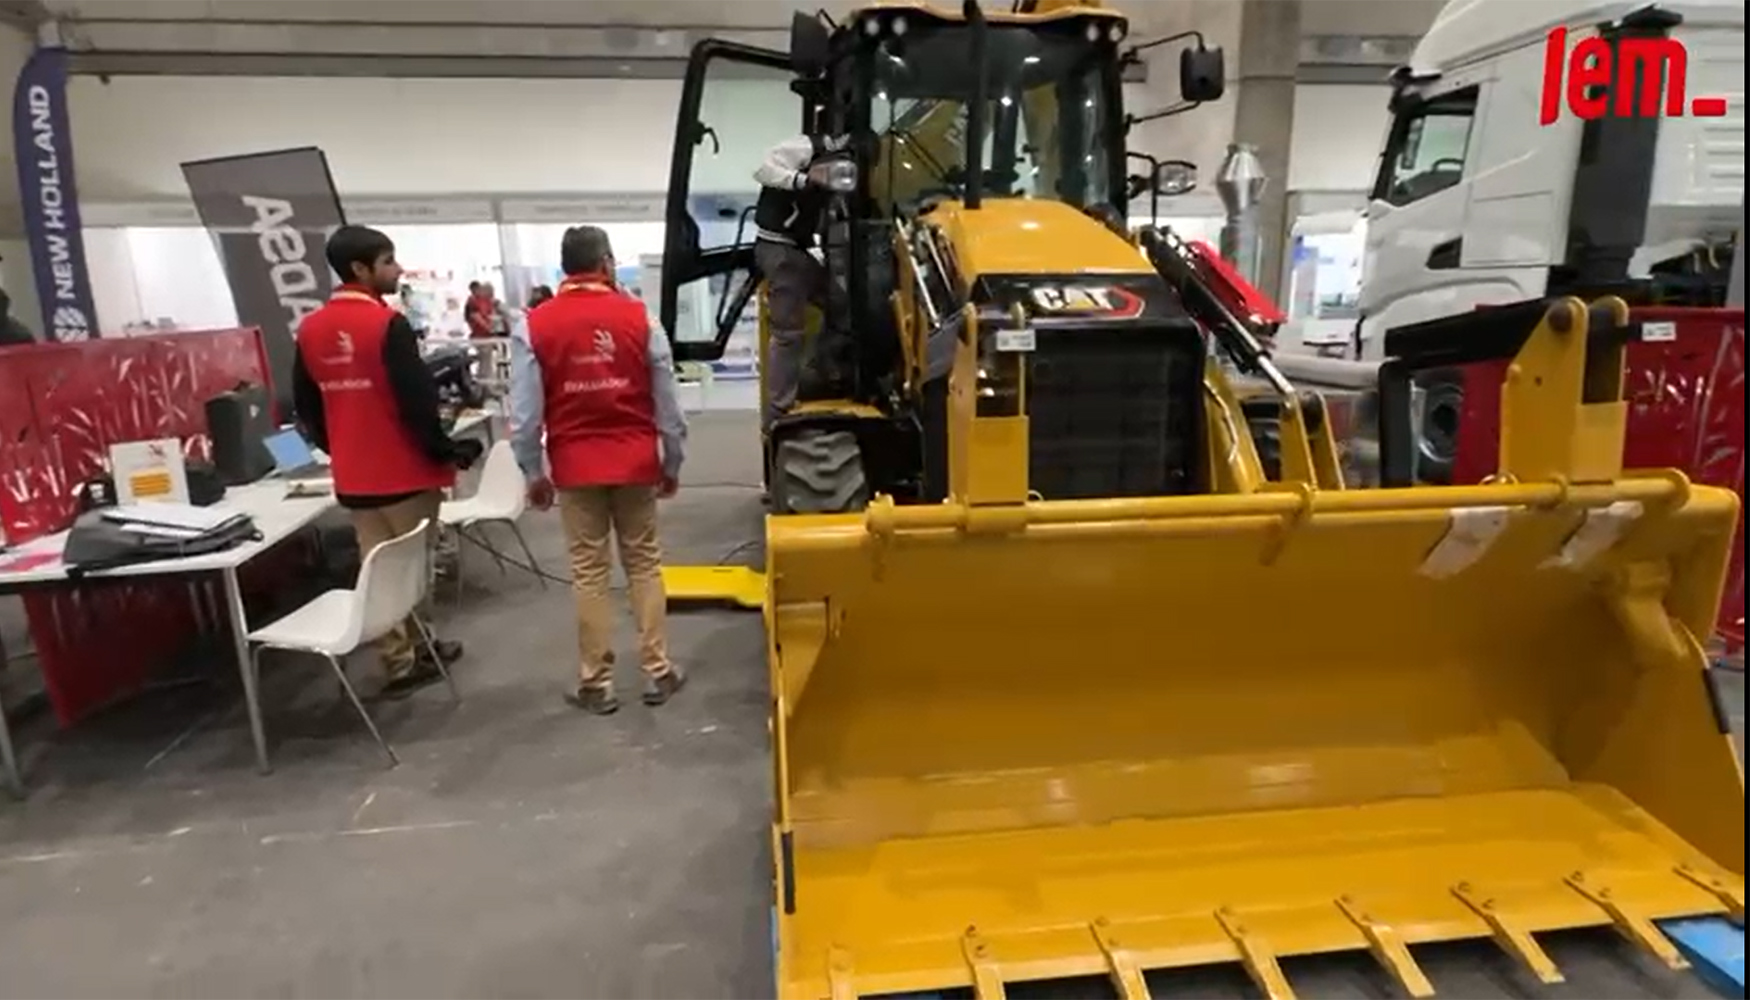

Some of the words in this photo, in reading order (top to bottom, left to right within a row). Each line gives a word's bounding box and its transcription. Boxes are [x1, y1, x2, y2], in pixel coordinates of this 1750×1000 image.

[29, 84, 65, 230] HOLLAND
[46, 234, 76, 299] NEW
[1032, 287, 1114, 310] CAT
